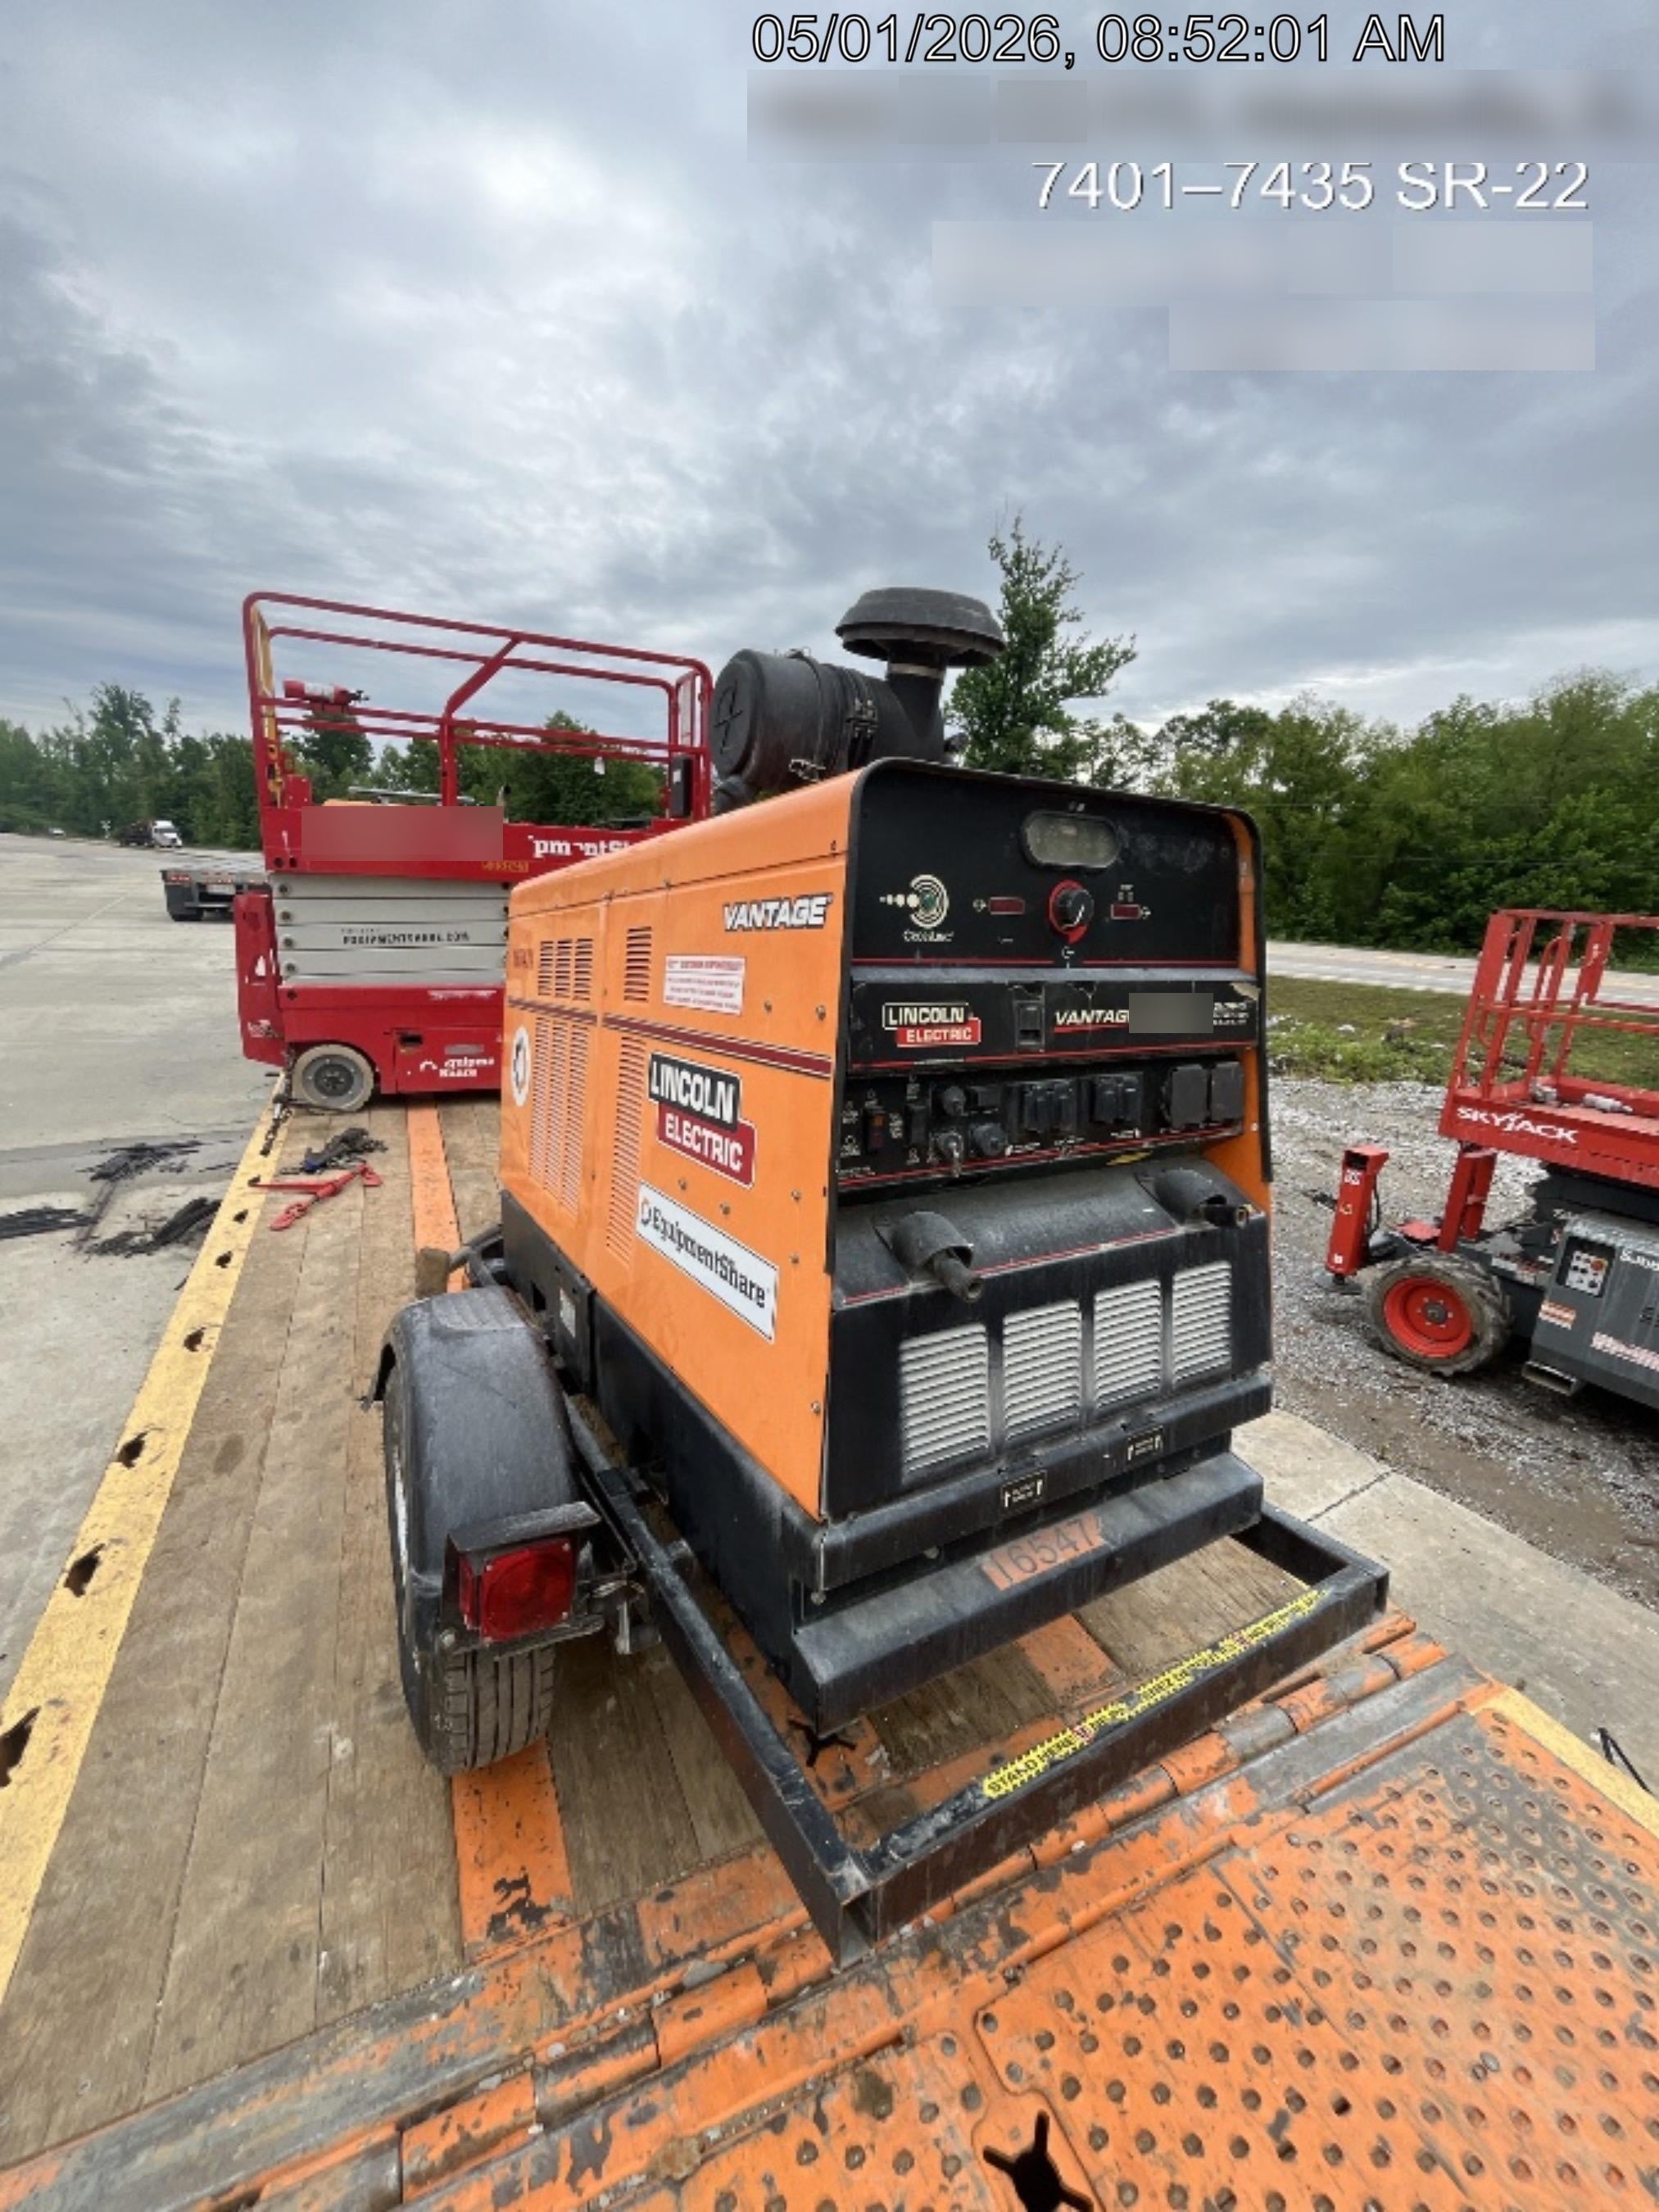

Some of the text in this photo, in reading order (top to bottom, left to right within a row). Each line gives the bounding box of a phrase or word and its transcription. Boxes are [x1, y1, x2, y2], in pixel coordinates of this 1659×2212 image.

[723, 894, 830, 931] VANTAGE
[888, 1007, 965, 1026] LINCOLN
[905, 1027, 972, 1043] ELECTRIC
[1054, 1009, 1130, 1025] VANTAG
[650, 1061, 736, 1124] LINCOLN
[664, 1113, 743, 1172] ELECTRIC
[1457, 1106, 1579, 1144] SKYJACK
[652, 1206, 766, 1308] EquipmentShare
